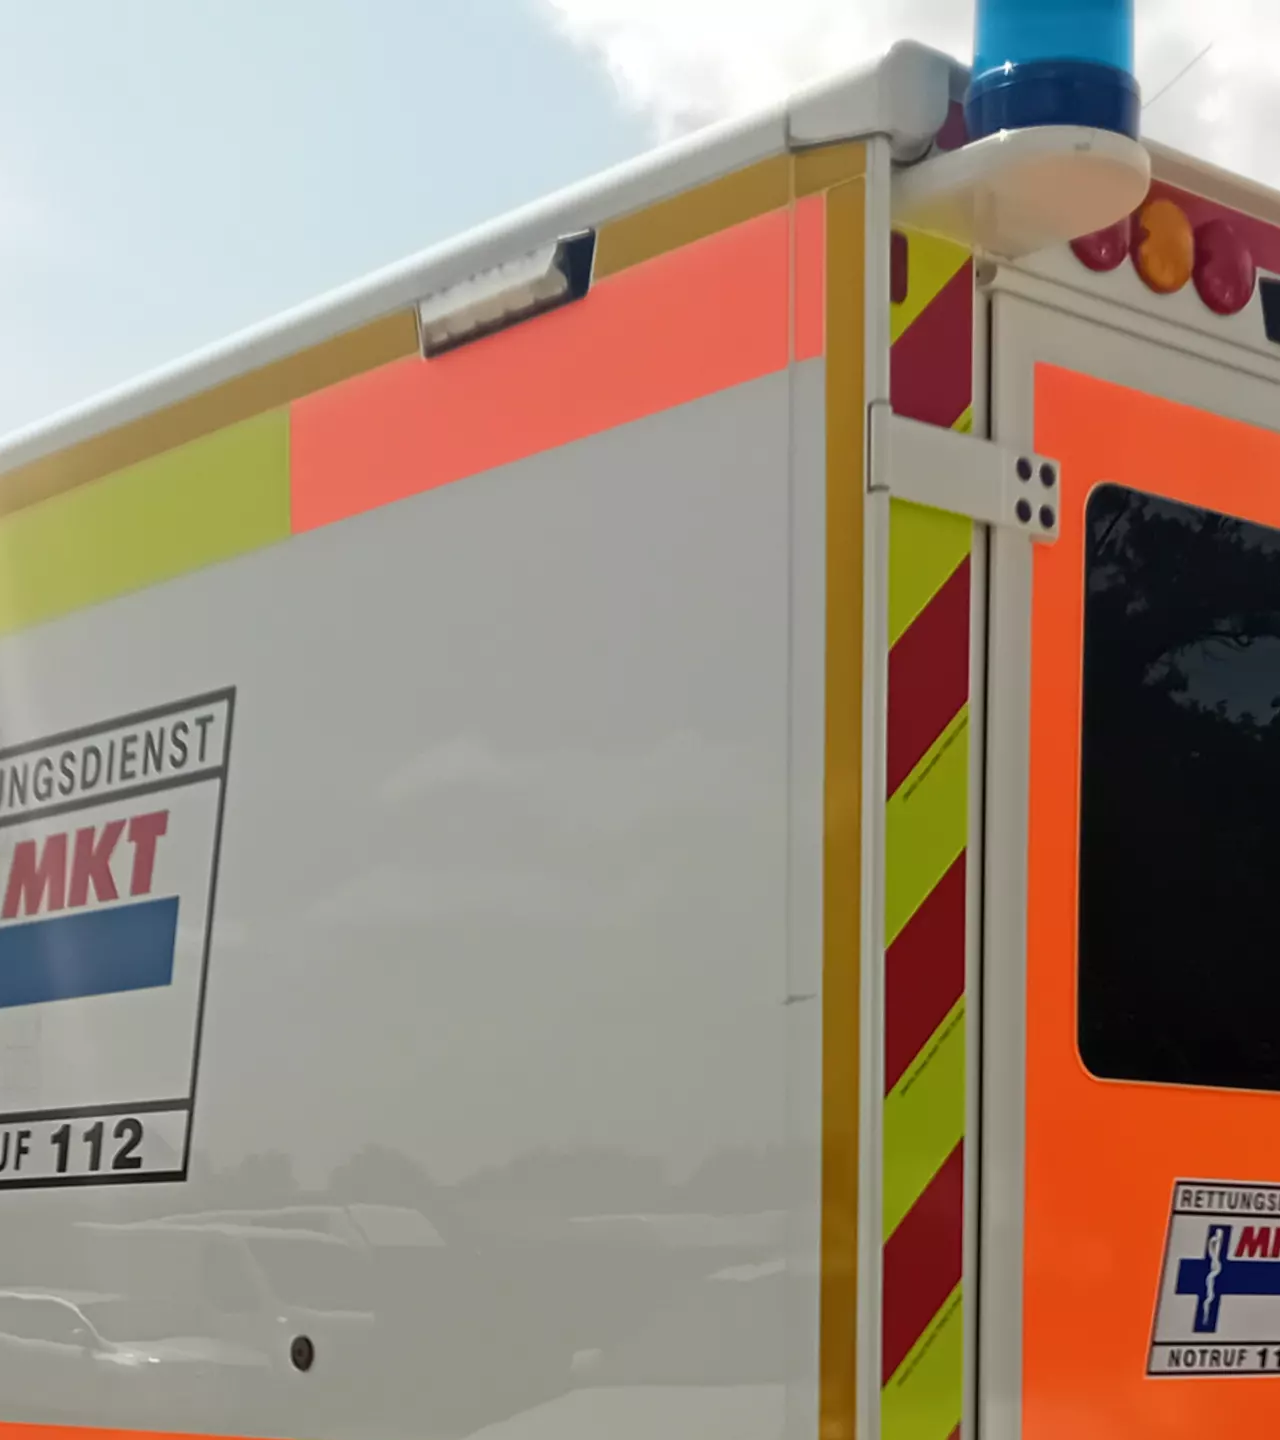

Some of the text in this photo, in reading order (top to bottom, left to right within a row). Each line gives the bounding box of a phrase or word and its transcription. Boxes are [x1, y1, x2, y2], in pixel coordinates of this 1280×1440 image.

[0, 810, 170, 920] MKT
[50, 1118, 144, 1174] 112
[1168, 1349, 1248, 1368] NOTRUF
